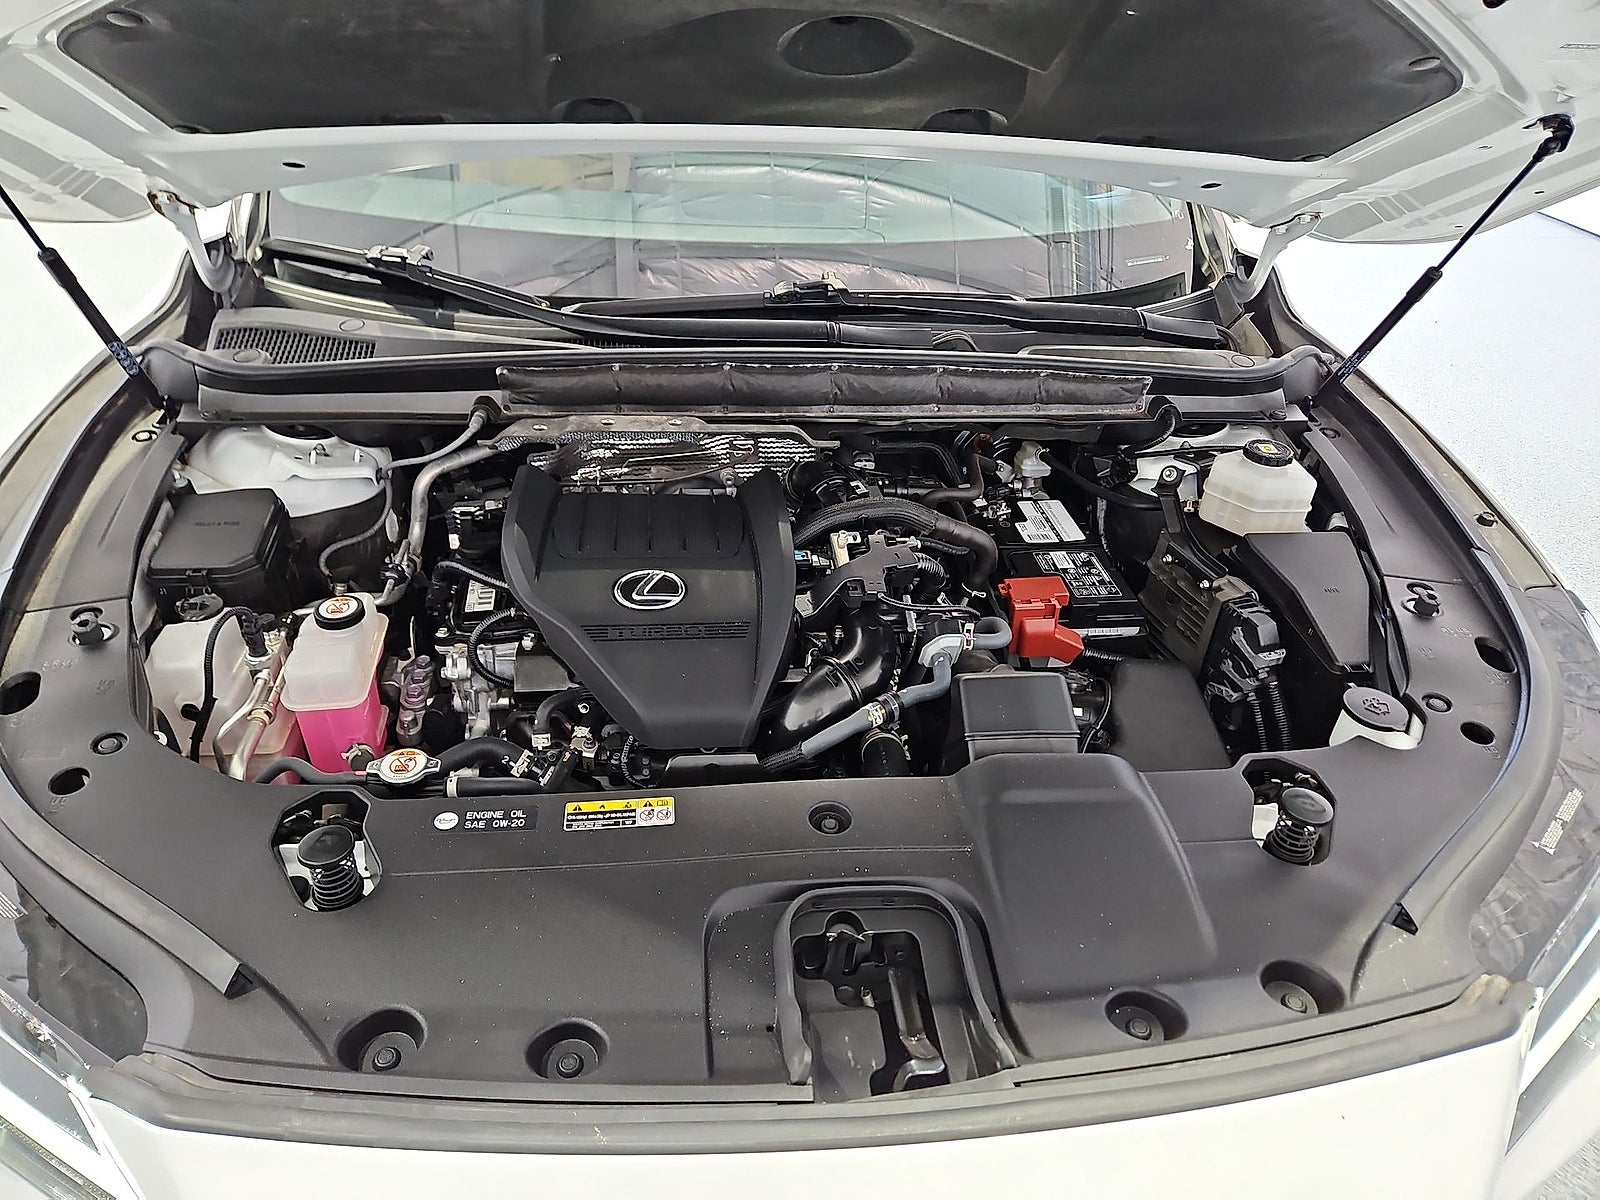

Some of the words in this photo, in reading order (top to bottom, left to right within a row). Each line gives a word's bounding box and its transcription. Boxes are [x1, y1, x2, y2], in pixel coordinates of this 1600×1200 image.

[608, 625, 704, 639] TURBO
[466, 810, 504, 820] ENGINE
[511, 809, 527, 818] OIL
[464, 820, 486, 829] SAE
[492, 818, 525, 828] 0W-20
